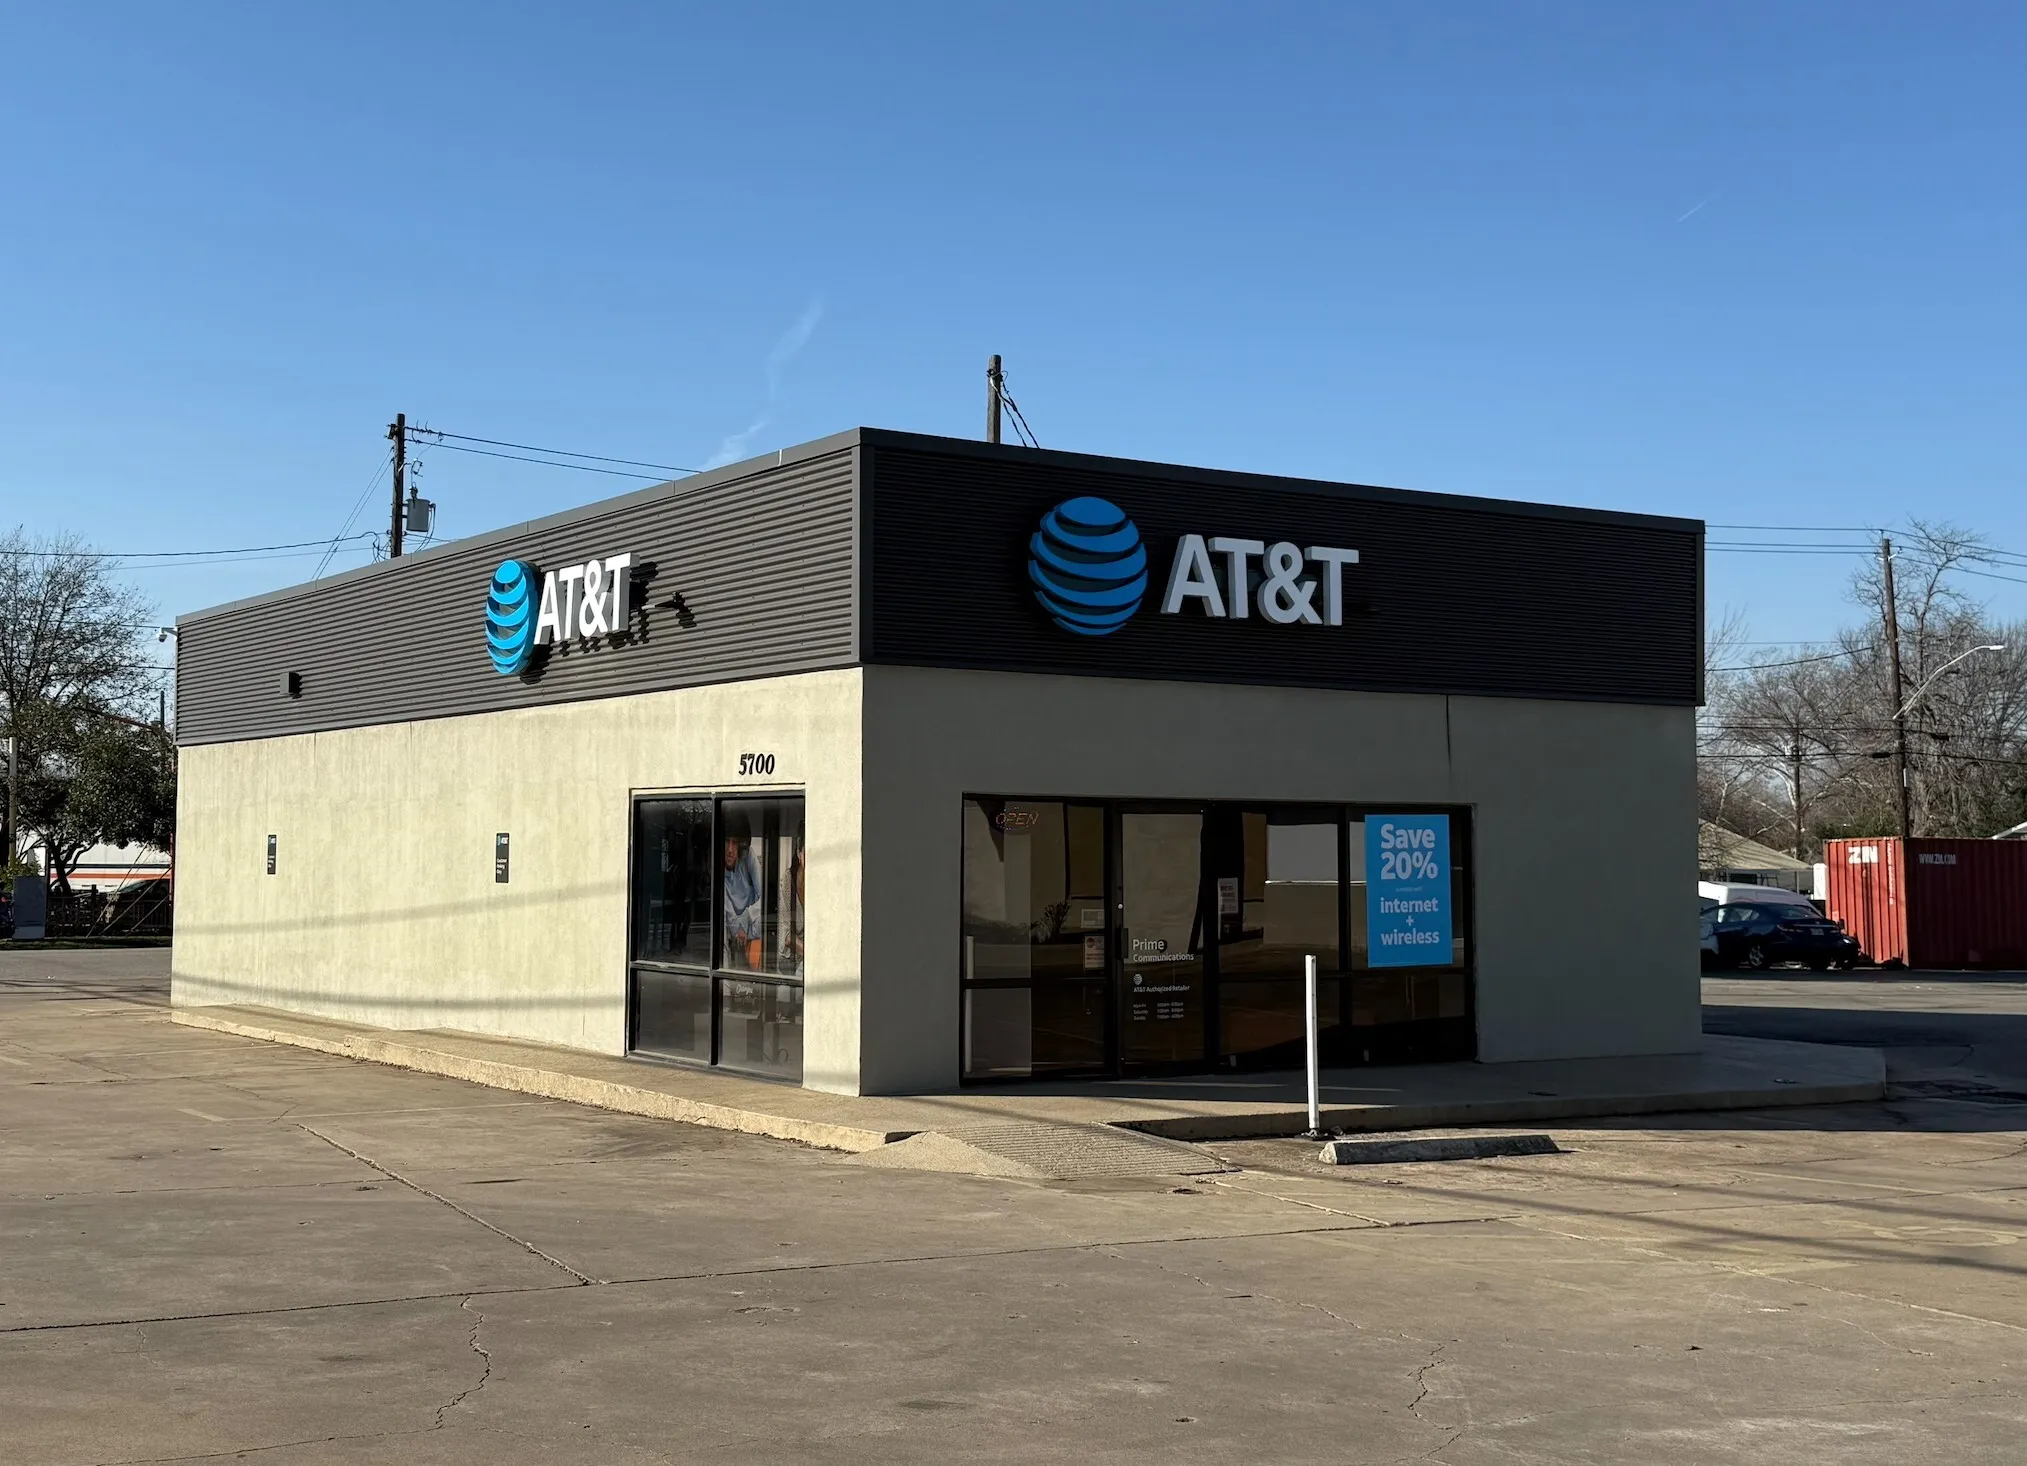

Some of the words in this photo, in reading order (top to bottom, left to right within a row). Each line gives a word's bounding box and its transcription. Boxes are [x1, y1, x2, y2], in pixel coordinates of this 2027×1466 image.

[1160, 534, 1359, 626] AT&T
[534, 552, 637, 645] AT&T
[739, 753, 776, 776] 5700
[995, 811, 1039, 826] OPEN
[1380, 823, 1436, 849] Save
[1380, 851, 1439, 880] 20%
[1380, 897, 1439, 914] internet
[1133, 939, 1164, 951] Prime
[1380, 928, 1440, 946] wireless
[1133, 953, 1194, 962] Communications
